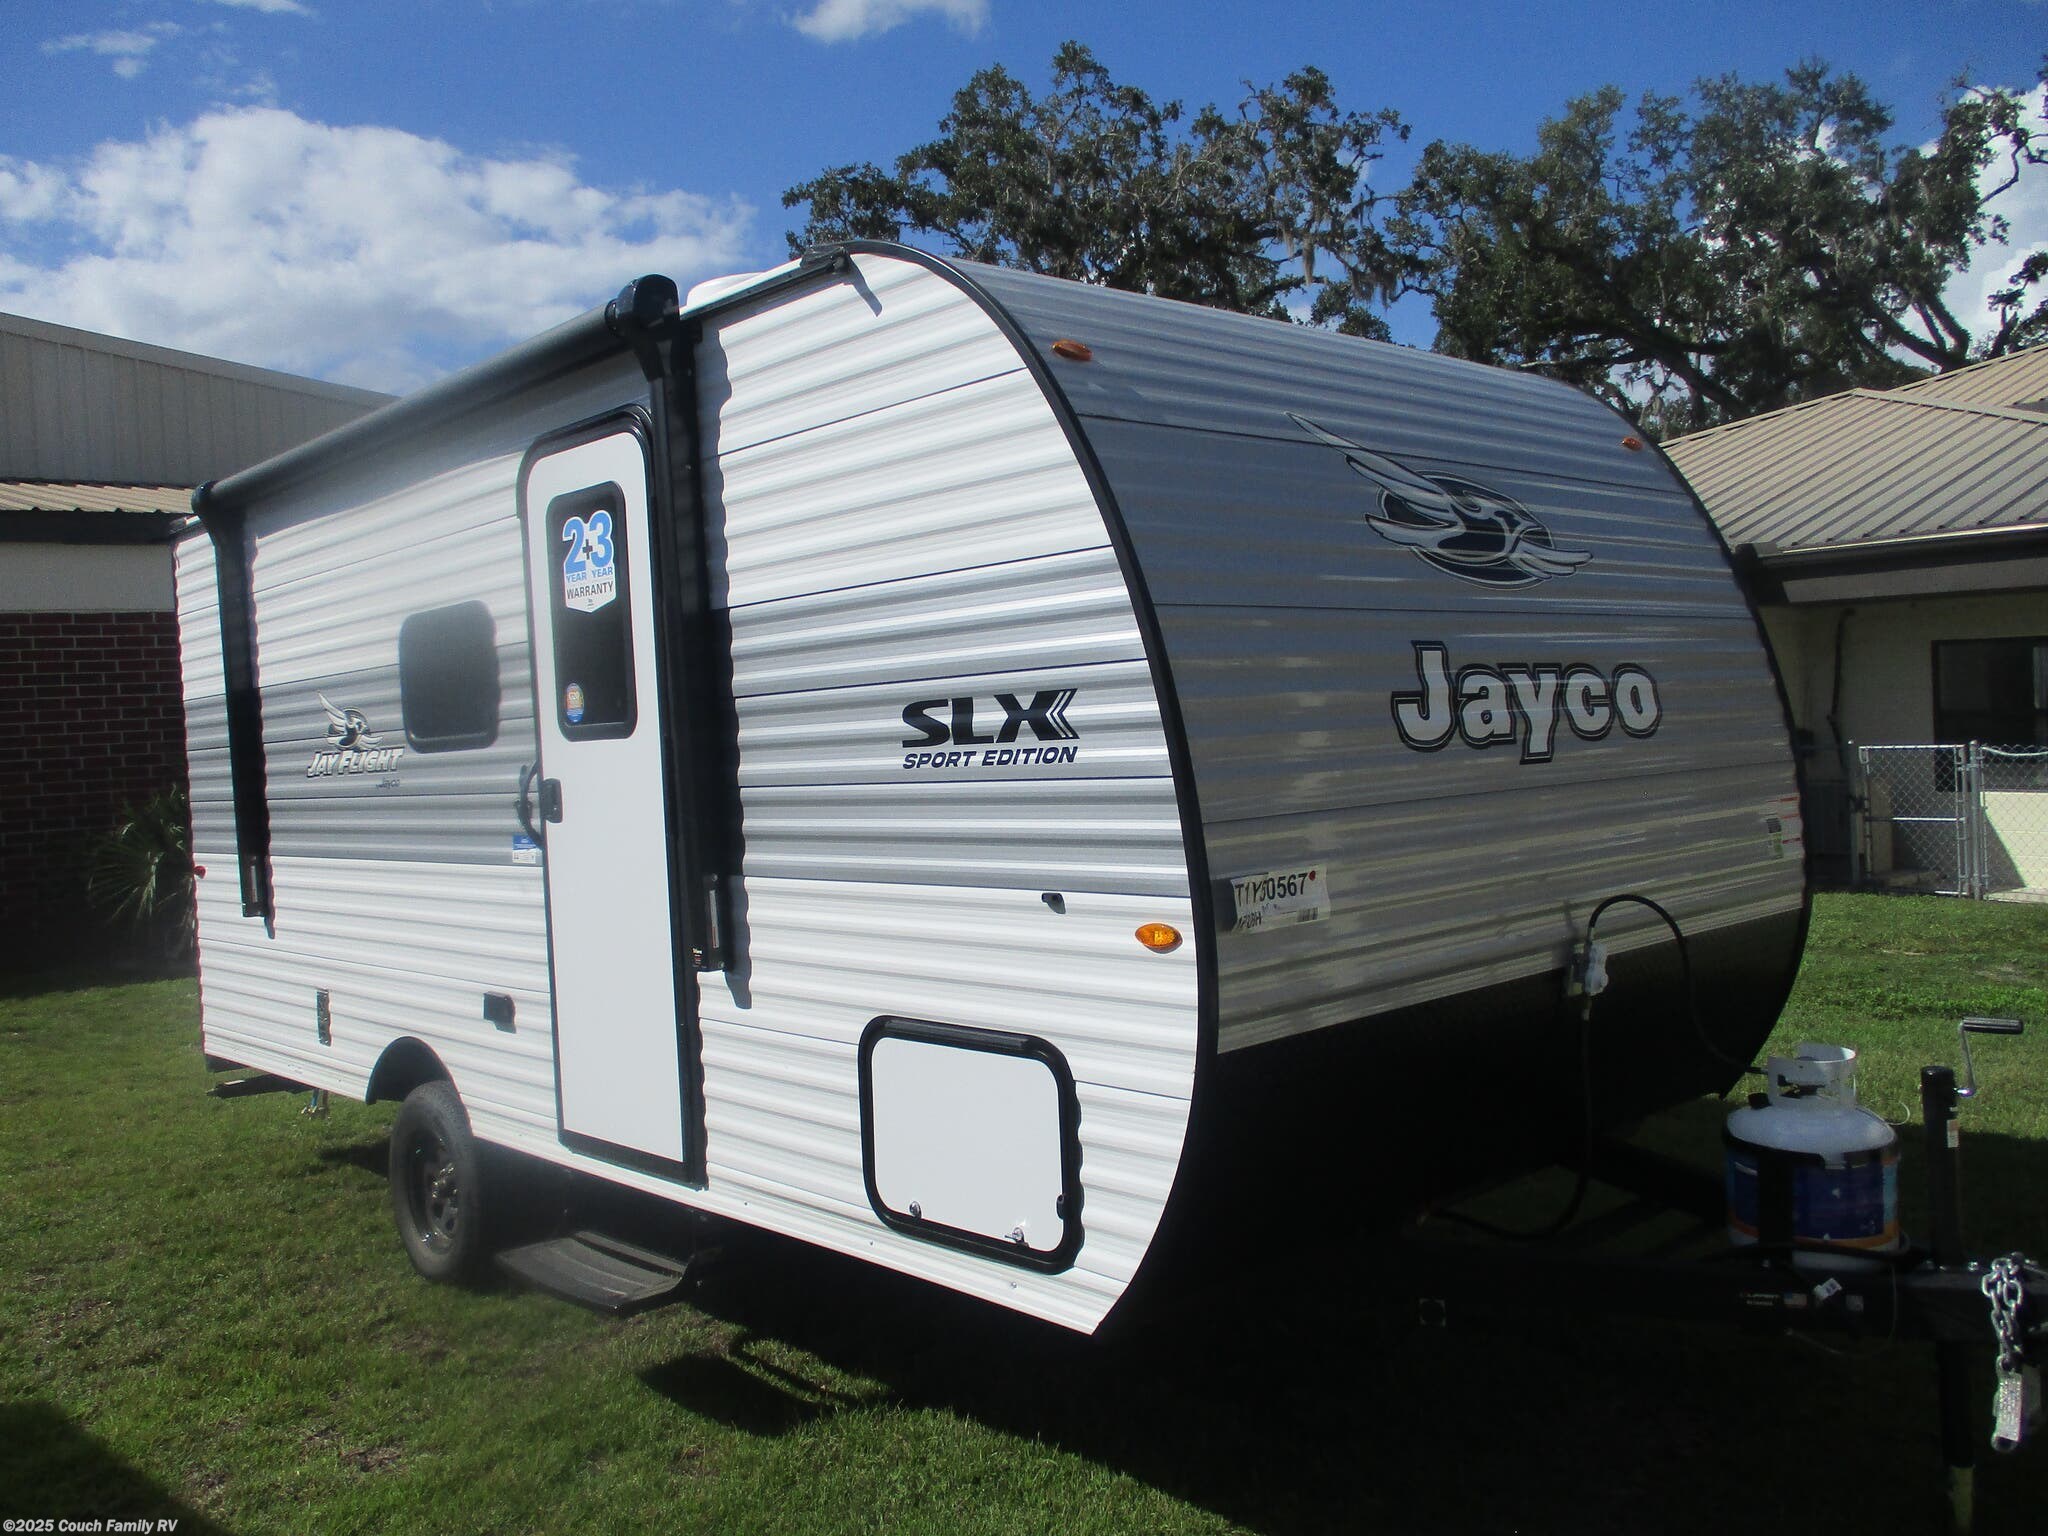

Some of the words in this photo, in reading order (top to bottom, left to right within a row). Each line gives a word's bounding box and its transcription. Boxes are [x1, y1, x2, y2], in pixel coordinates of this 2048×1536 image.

[566, 573, 587, 584] YEAR
[592, 566, 613, 578] YEAR
[567, 581, 614, 599] WARRANTY
[1391, 640, 1662, 765] Jayco
[902, 688, 1080, 748] SLX
[306, 751, 340, 778] JAY
[337, 746, 405, 774] FLIGHT
[903, 751, 977, 770] SPORT
[982, 746, 1079, 767] EDITION
